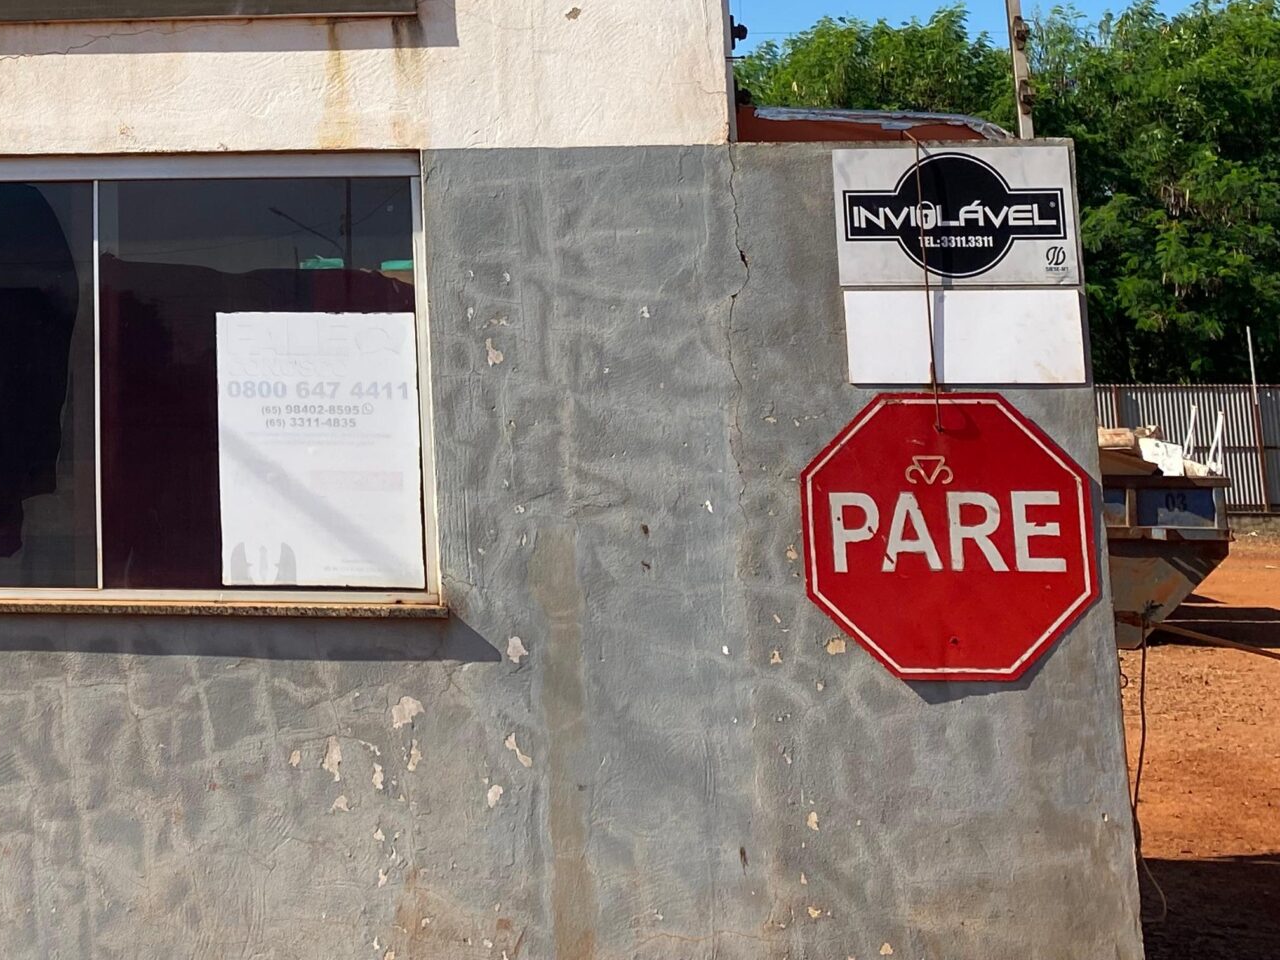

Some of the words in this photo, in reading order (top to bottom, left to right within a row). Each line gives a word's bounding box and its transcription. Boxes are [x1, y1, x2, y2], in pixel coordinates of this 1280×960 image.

[853, 200, 1057, 230] INVIOLÁVEL
[227, 380, 287, 399] 0800
[295, 380, 341, 400] 647
[350, 381, 409, 400] 4411
[261, 405, 281, 416] (65)
[289, 417, 357, 429] 3311-4835
[828, 490, 1067, 573] PARE
